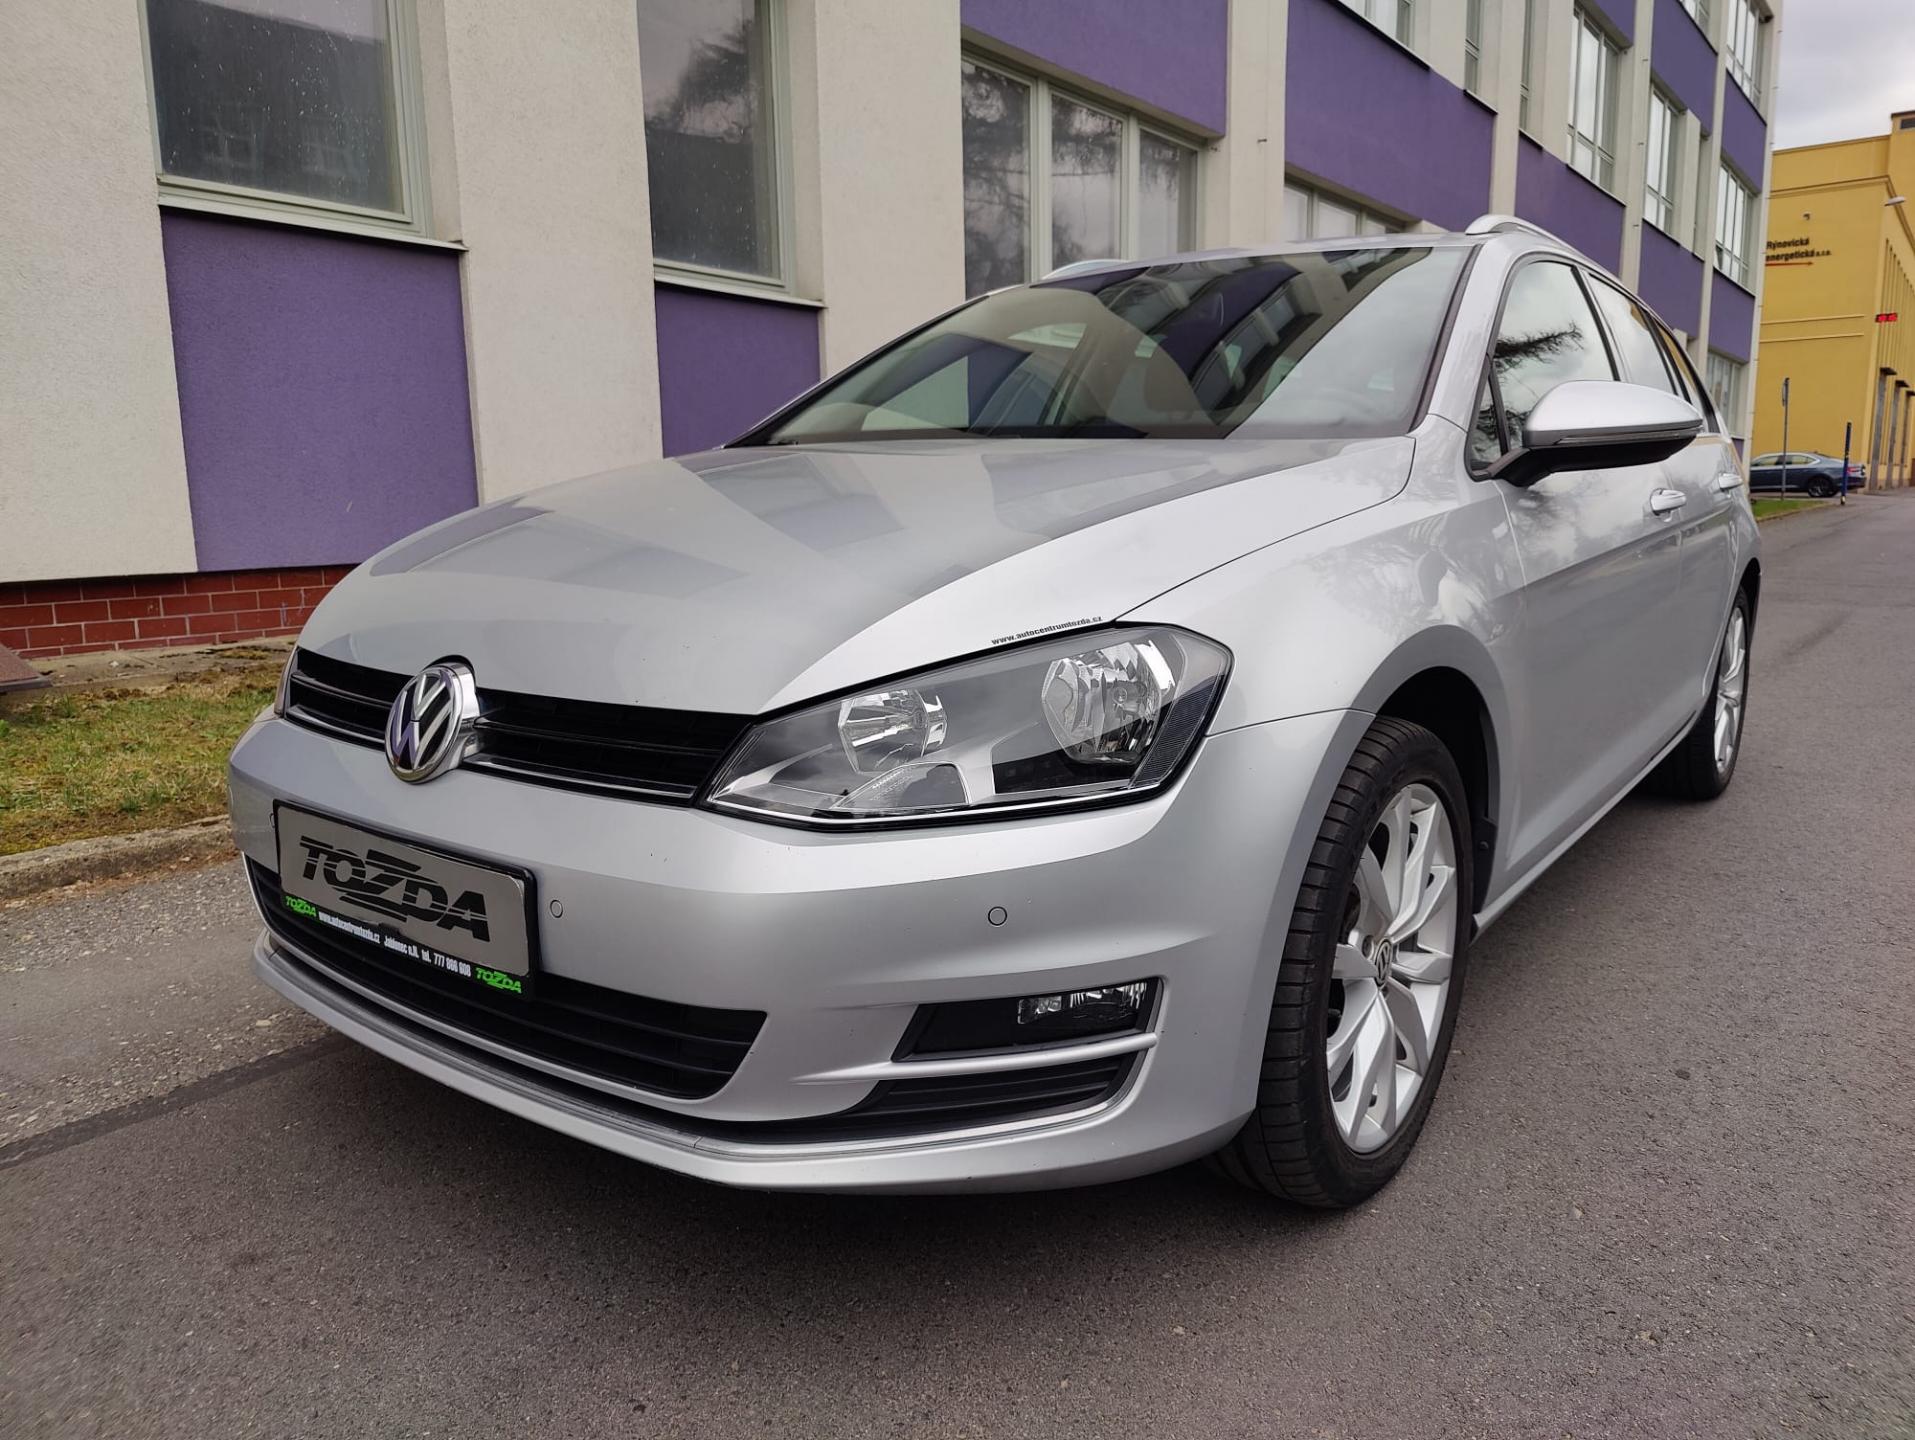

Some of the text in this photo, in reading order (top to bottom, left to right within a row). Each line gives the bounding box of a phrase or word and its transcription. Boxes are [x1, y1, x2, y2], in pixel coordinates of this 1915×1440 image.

[991, 615, 1103, 645] www.autocentrumtozda.cz
[299, 835, 490, 942] TOZDA
[285, 895, 317, 918] TOZDA
[433, 952, 445, 968] 777
[475, 965, 522, 994] TOZDA
